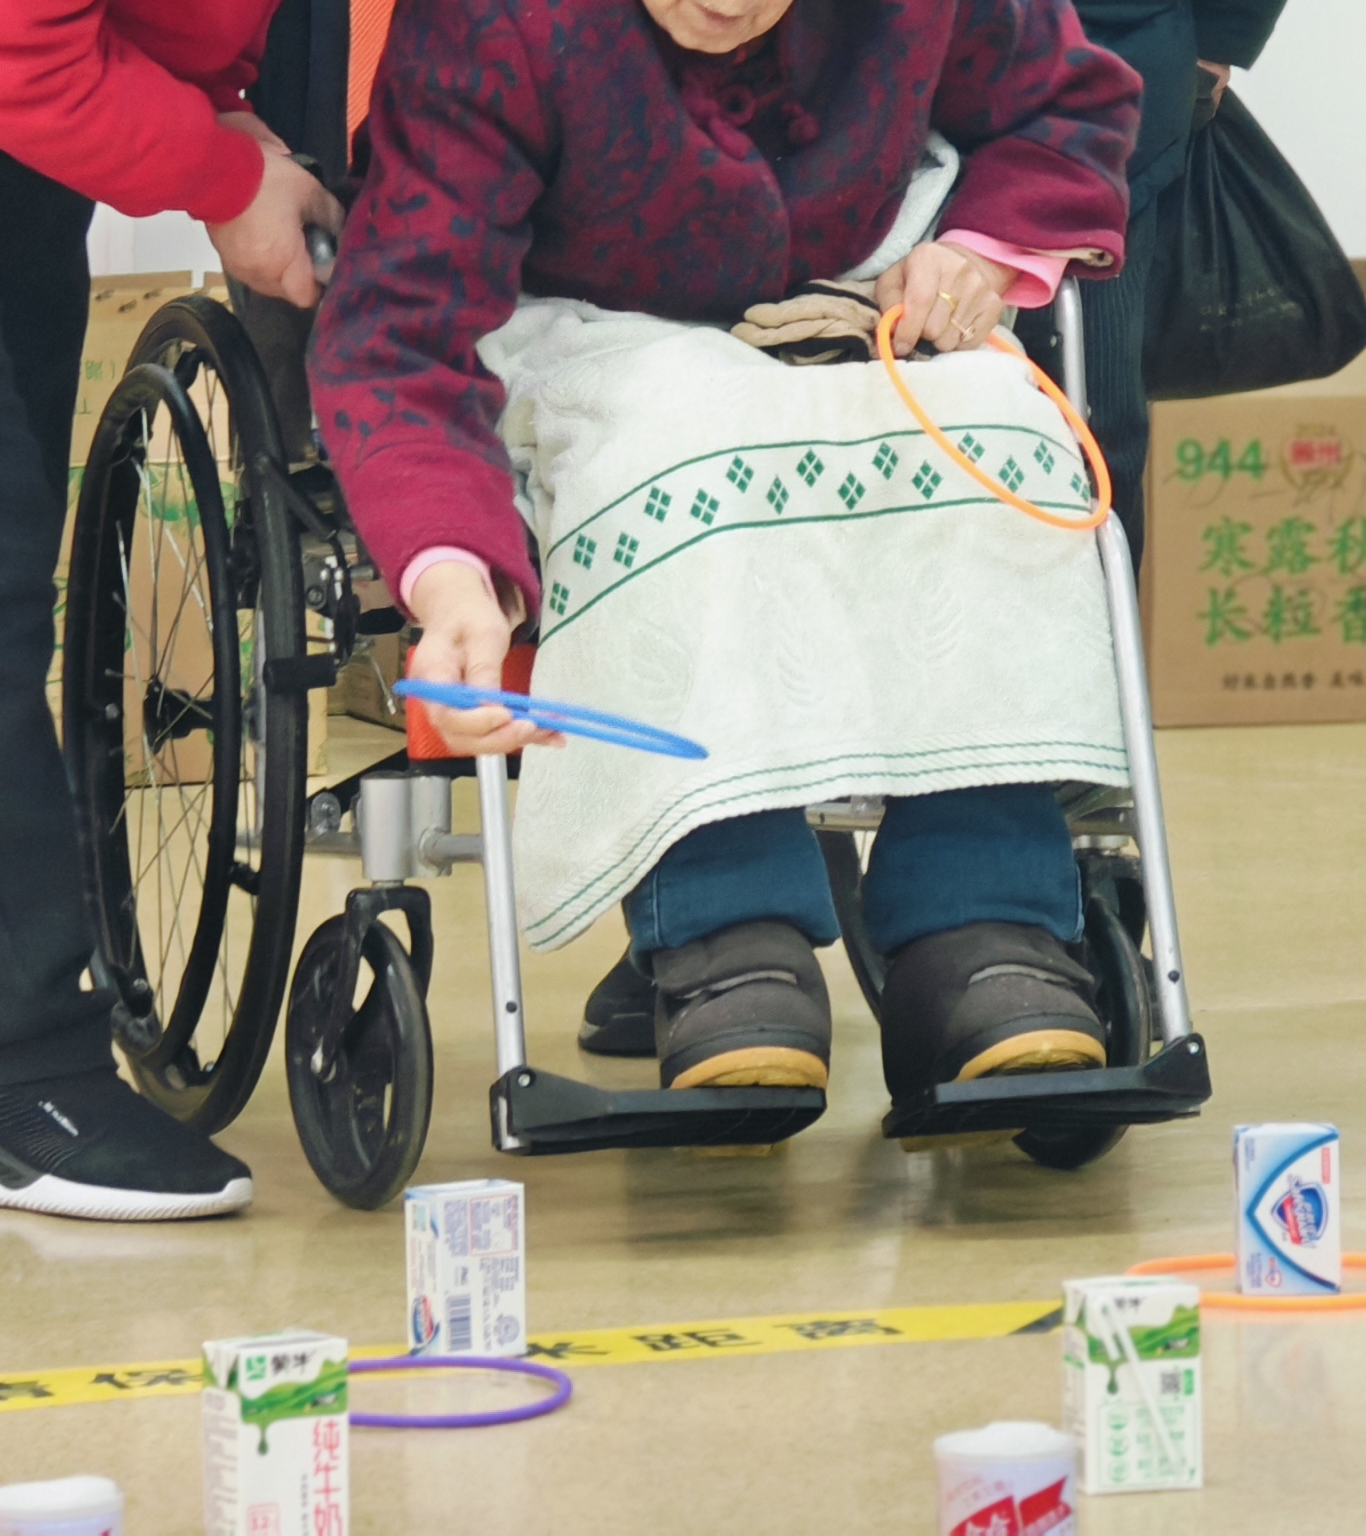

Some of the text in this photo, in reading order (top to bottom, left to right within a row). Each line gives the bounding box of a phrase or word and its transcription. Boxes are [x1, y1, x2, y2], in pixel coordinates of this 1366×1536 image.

[1175, 438, 1264, 482] 944
[312, 1419, 343, 1536] 纯牛奶
